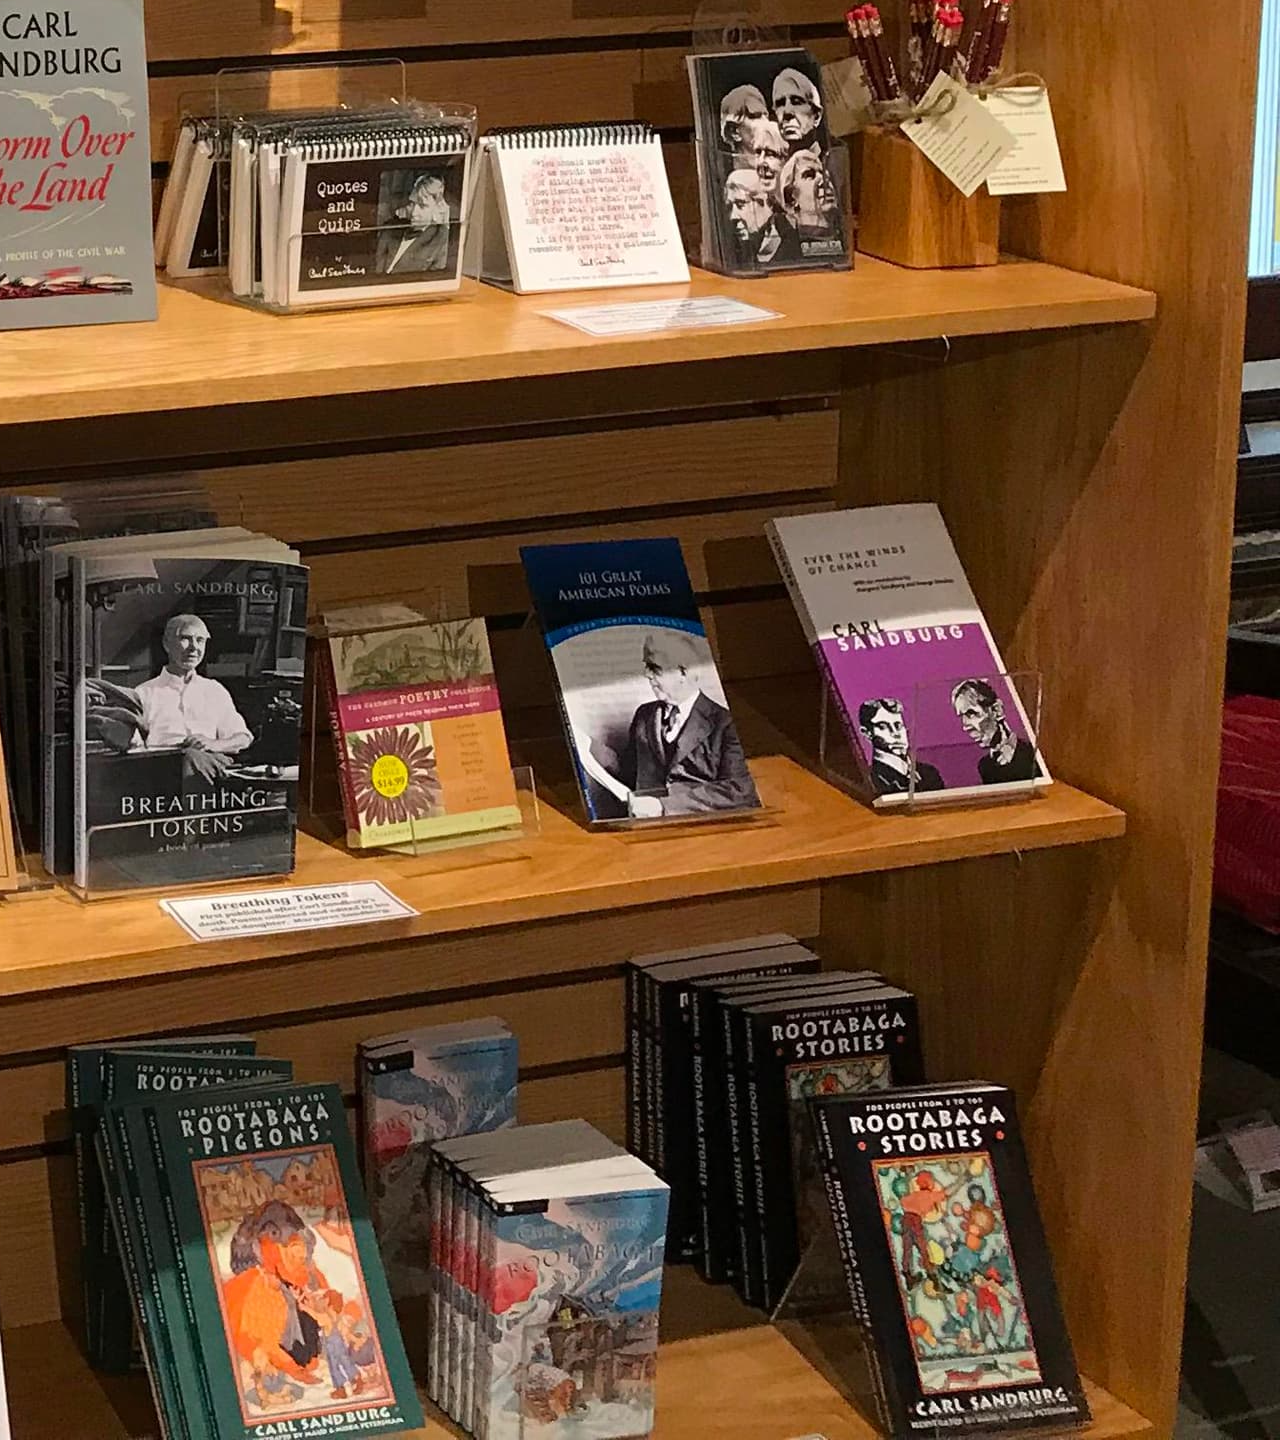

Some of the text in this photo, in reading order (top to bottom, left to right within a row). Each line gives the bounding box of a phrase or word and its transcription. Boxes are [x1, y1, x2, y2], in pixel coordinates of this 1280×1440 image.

[1, 11, 78, 40] CARL
[61, 115, 135, 158] Over
[20, 162, 113, 213] Land
[317, 180, 368, 198] Quotes
[327, 199, 355, 213] and
[318, 218, 361, 234] Quips
[579, 572, 598, 584] 101
[833, 620, 885, 638] CARL
[837, 625, 963, 651] SANDBURG
[121, 790, 266, 815] BREATHING
[146, 815, 244, 839] TOKENS
[180, 1104, 330, 1138] ROOTABAGA
[849, 1106, 1007, 1135] ROOTABAGA
[202, 1123, 321, 1155] PIGEONS
[881, 1129, 983, 1154] STORIES
